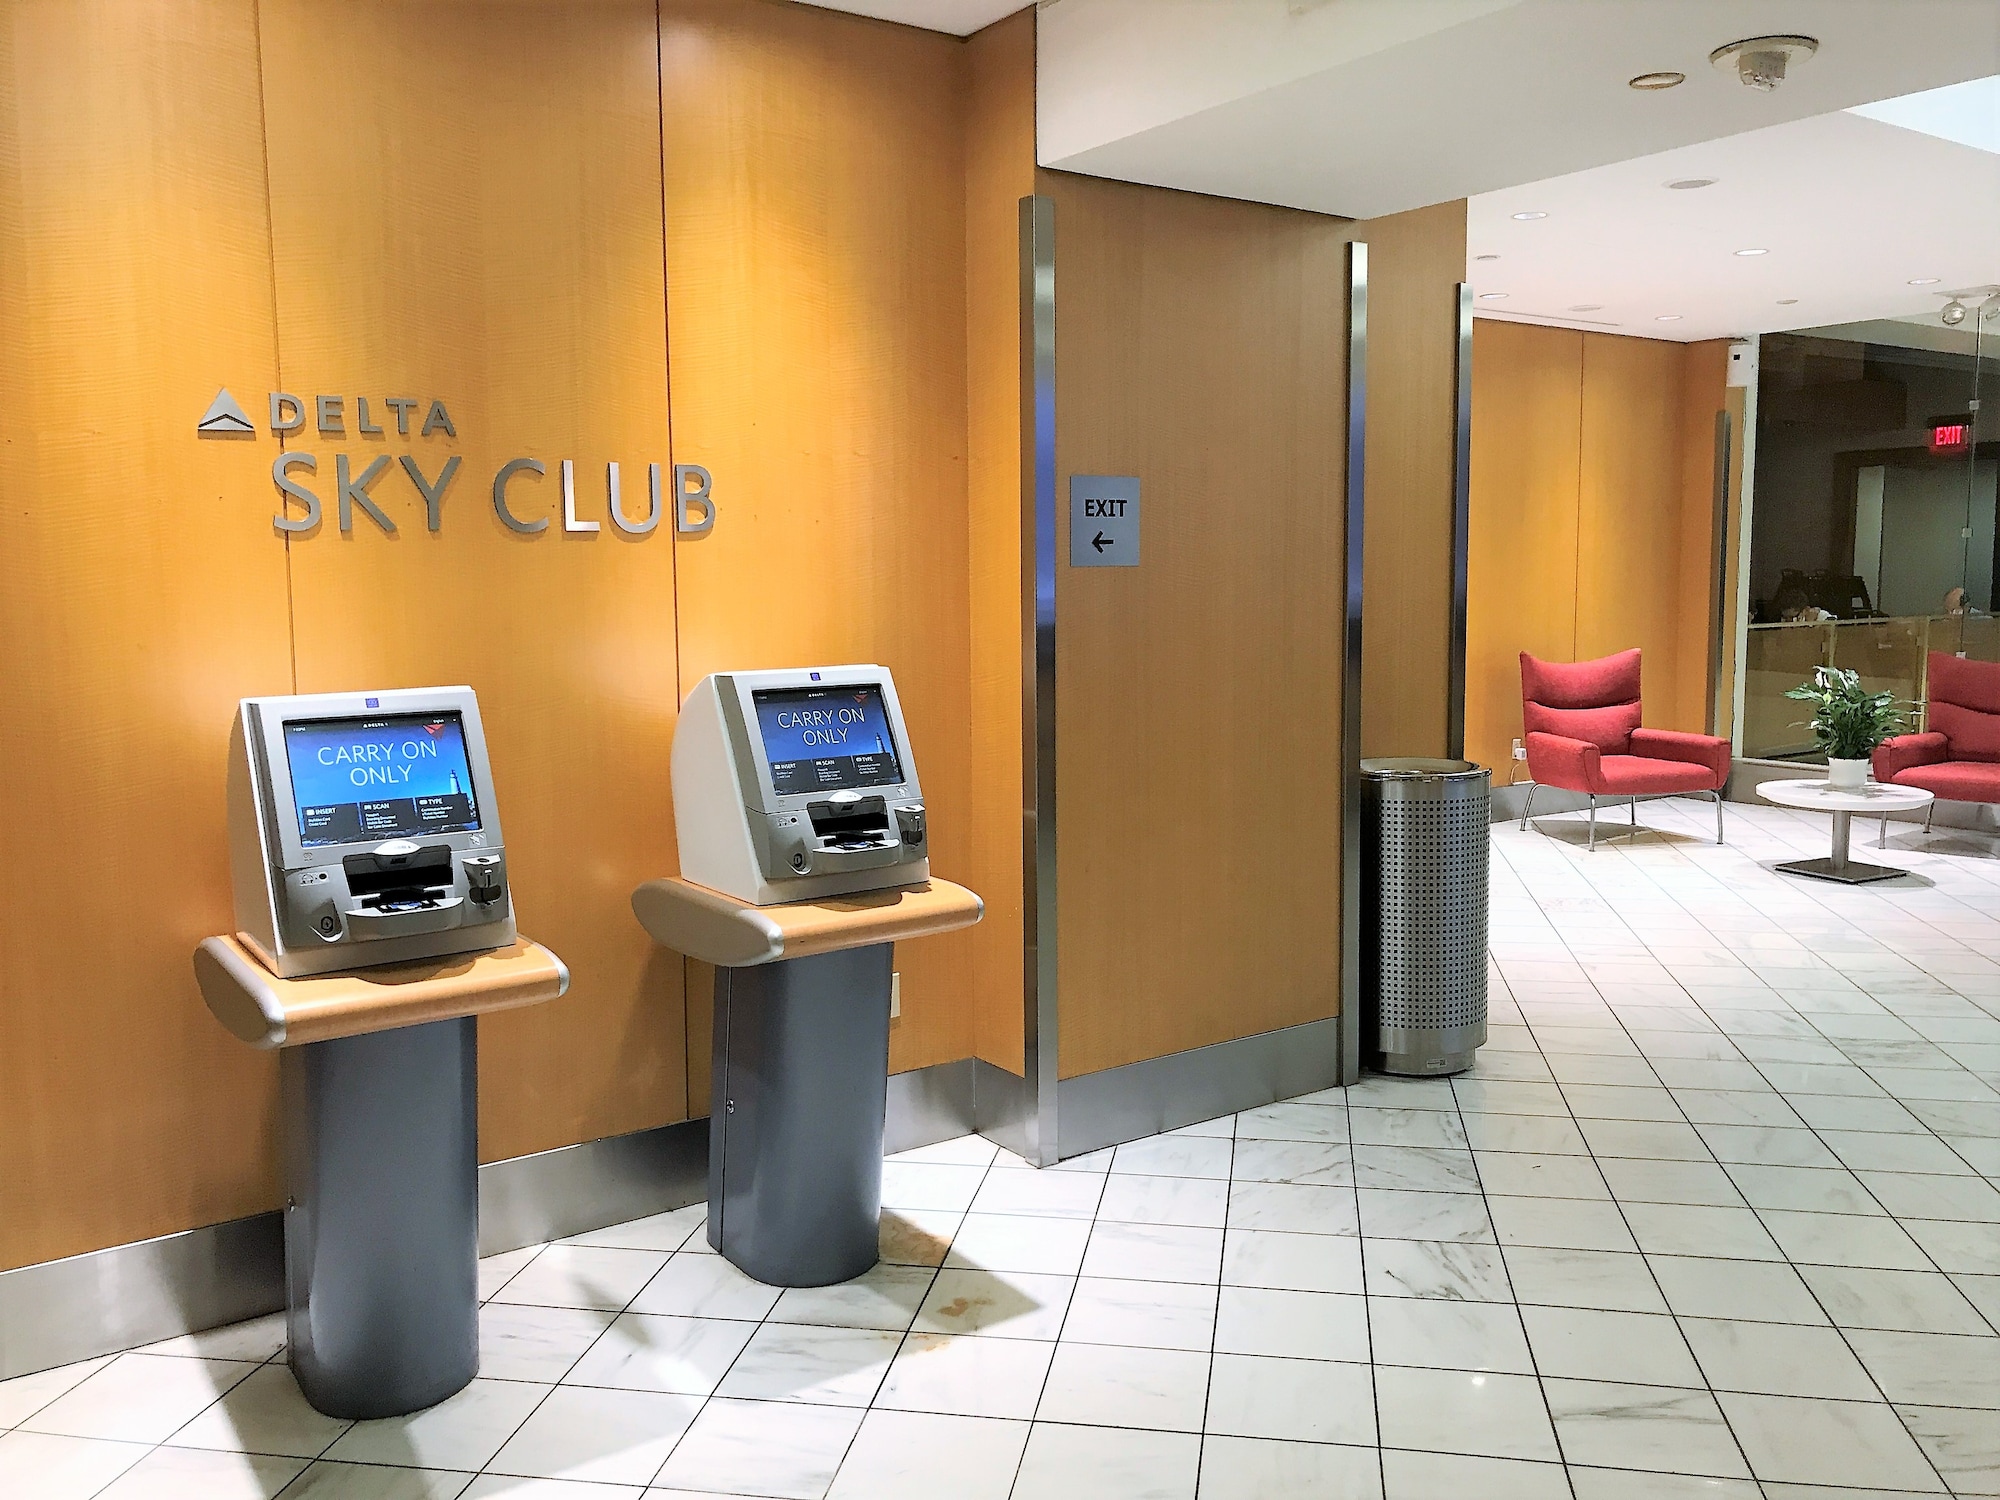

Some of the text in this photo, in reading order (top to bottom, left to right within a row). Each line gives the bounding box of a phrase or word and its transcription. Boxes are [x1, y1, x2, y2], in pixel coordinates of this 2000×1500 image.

[268, 392, 457, 437] DELTA
[1935, 424, 1963, 446] EXIT
[272, 451, 716, 534] SKY CLUB
[1084, 498, 1128, 518] EXIT
[777, 708, 865, 729] CARRY ON
[802, 727, 848, 747] ONLY
[317, 740, 437, 766] CARRY ON
[350, 763, 412, 787] ONLY
[315, 807, 337, 816] INSERT
[372, 802, 390, 810] SCAN
